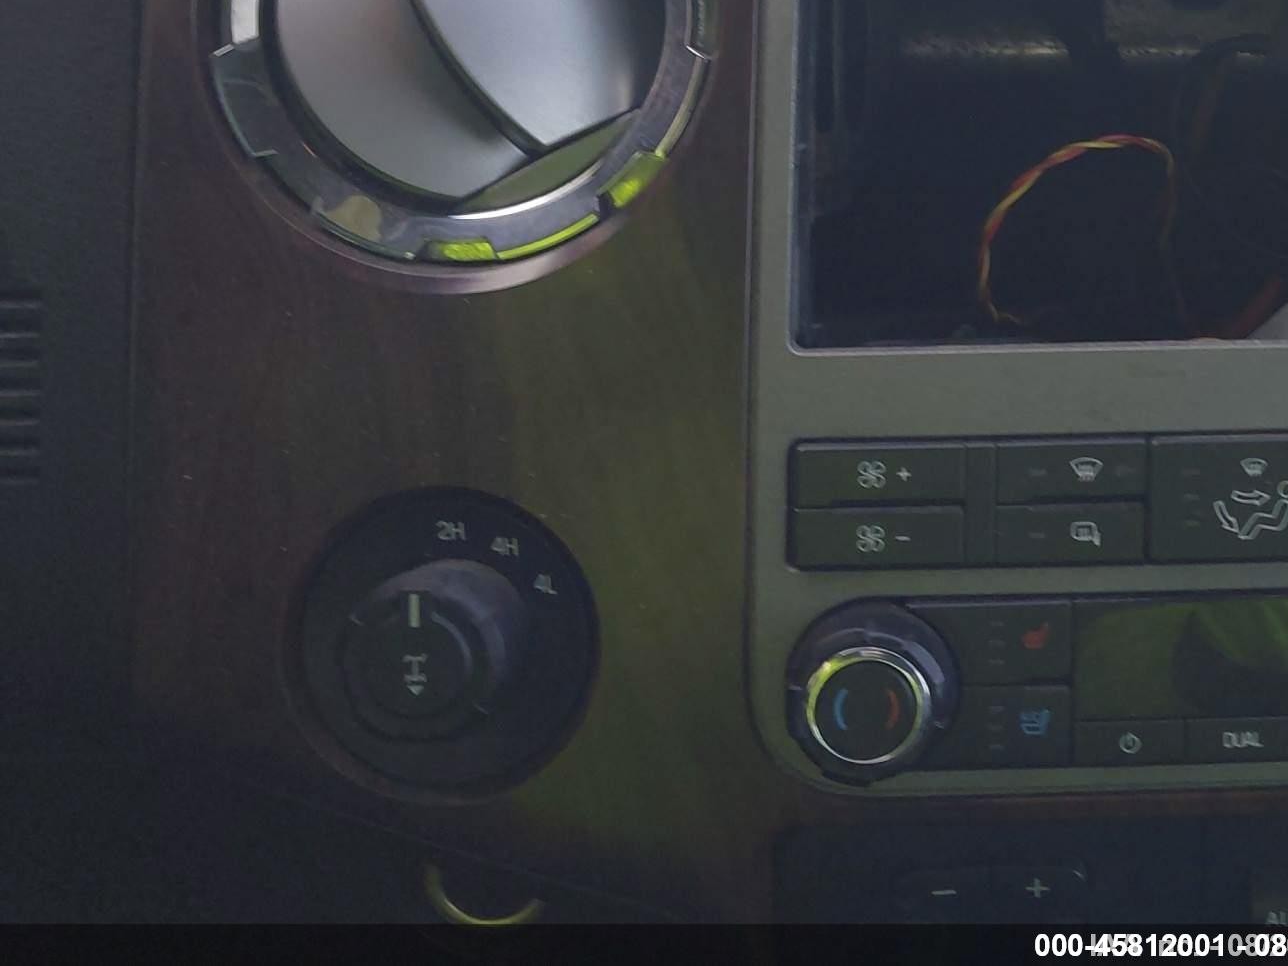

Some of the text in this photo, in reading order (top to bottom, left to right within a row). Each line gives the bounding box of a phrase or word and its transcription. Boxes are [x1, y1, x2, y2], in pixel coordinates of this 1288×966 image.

[435, 520, 465, 541] 2H
[490, 536, 520, 556] 4H
[533, 573, 558, 594] 4L
[1221, 731, 1265, 749] DUAL
